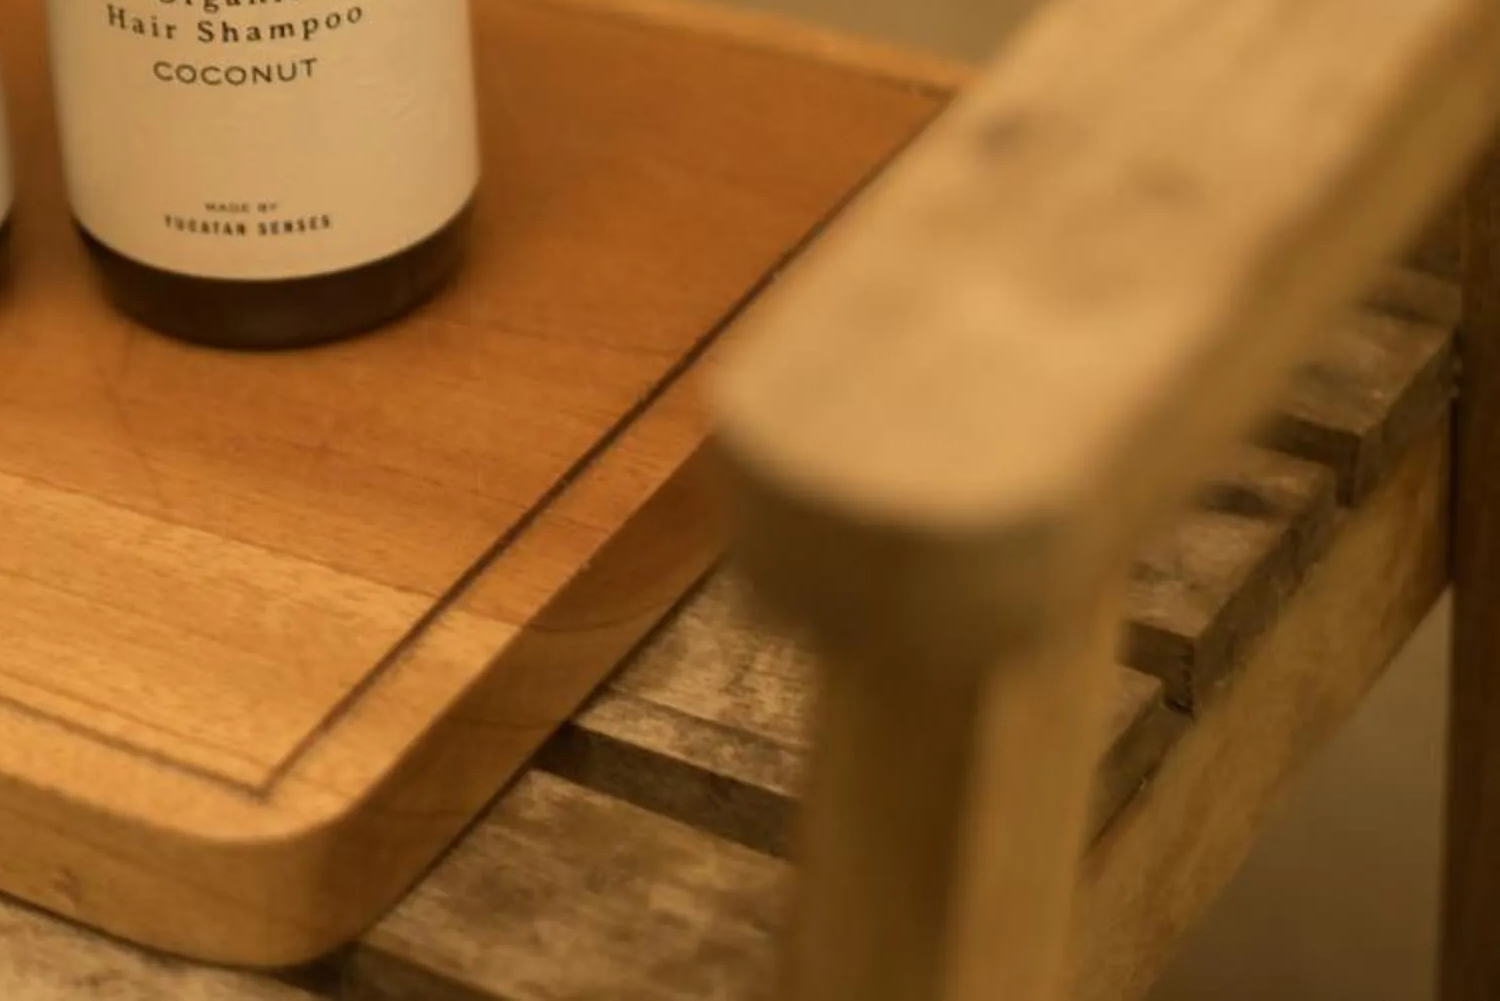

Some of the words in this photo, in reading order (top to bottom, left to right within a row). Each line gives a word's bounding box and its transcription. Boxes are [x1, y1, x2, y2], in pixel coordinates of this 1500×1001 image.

[106, 3, 177, 40] Hair
[197, 6, 363, 43] Shampoo
[153, 58, 317, 86] COCONUT
[257, 214, 330, 236] SENSES
